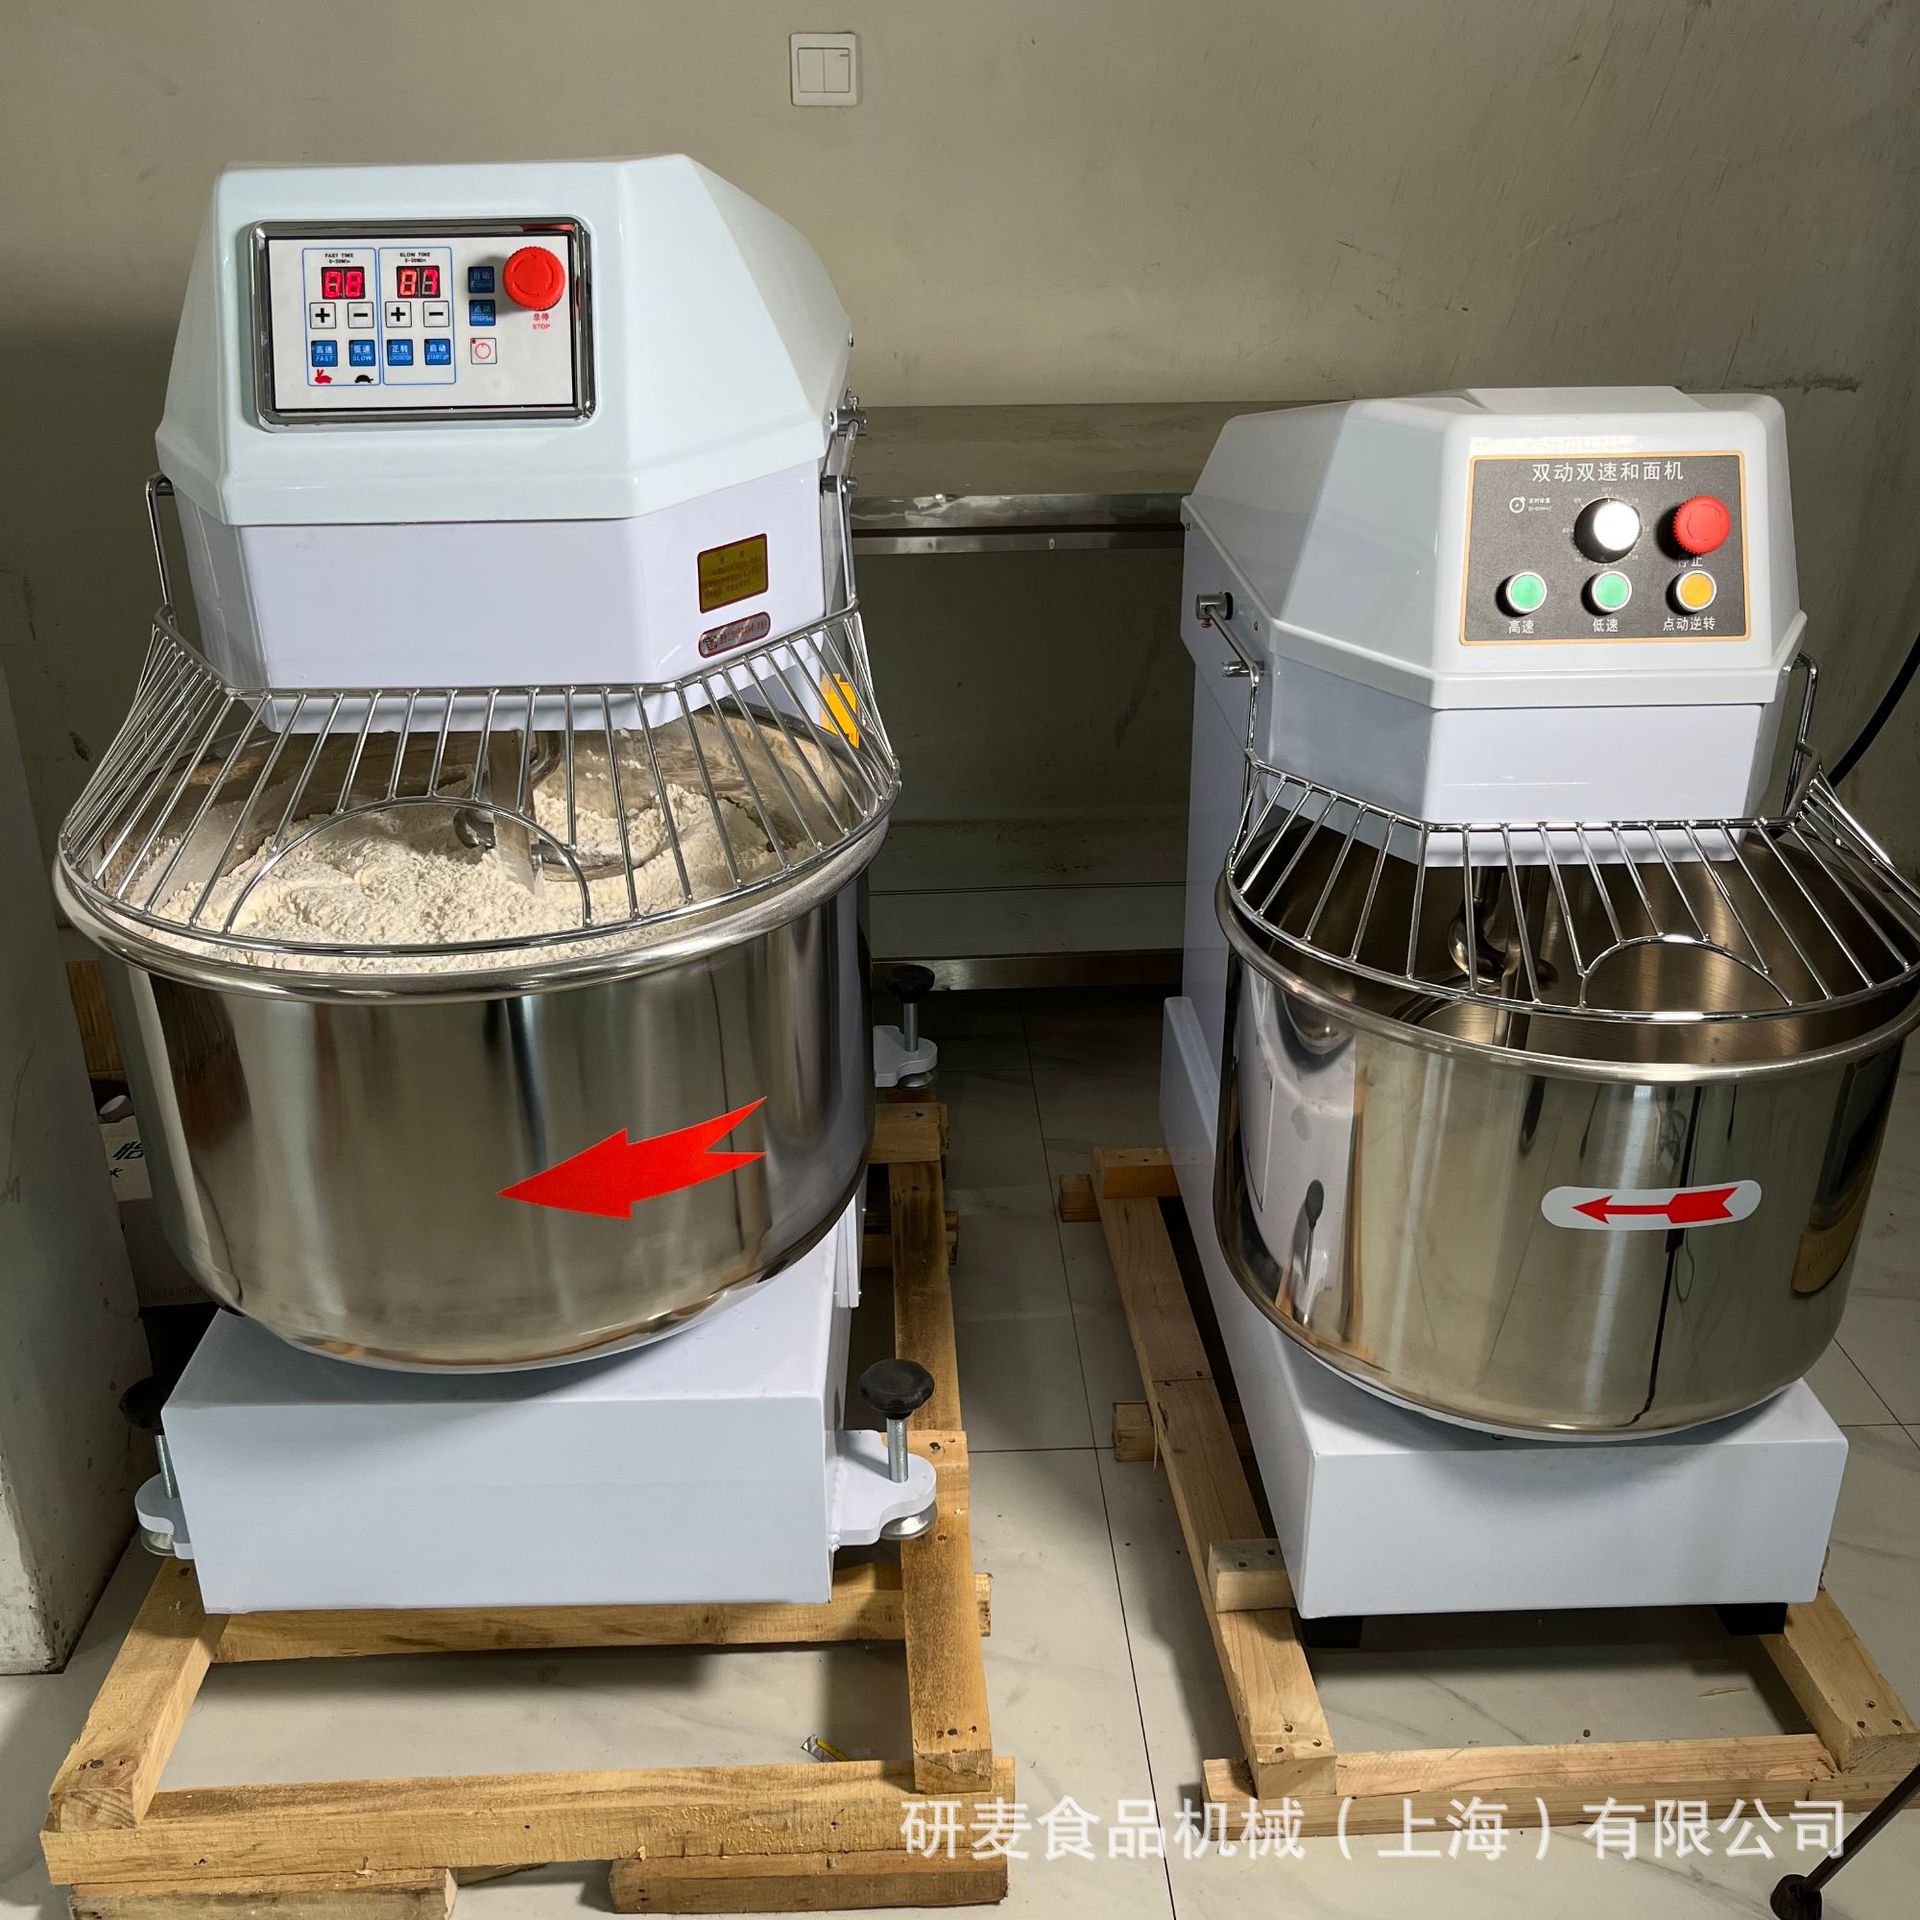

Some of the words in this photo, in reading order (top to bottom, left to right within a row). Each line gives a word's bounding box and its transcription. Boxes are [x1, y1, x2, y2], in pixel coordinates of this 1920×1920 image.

[316, 345, 333, 354] 高速
[353, 345, 371, 354] 低速
[391, 344, 408, 353] 正转
[429, 344, 447, 353] 启动
[1532, 461, 1684, 482] 双动双速和面机
[1508, 619, 1535, 634] 高速
[1593, 618, 1619, 633] 低速
[1662, 616, 1717, 632] 点动逆转
